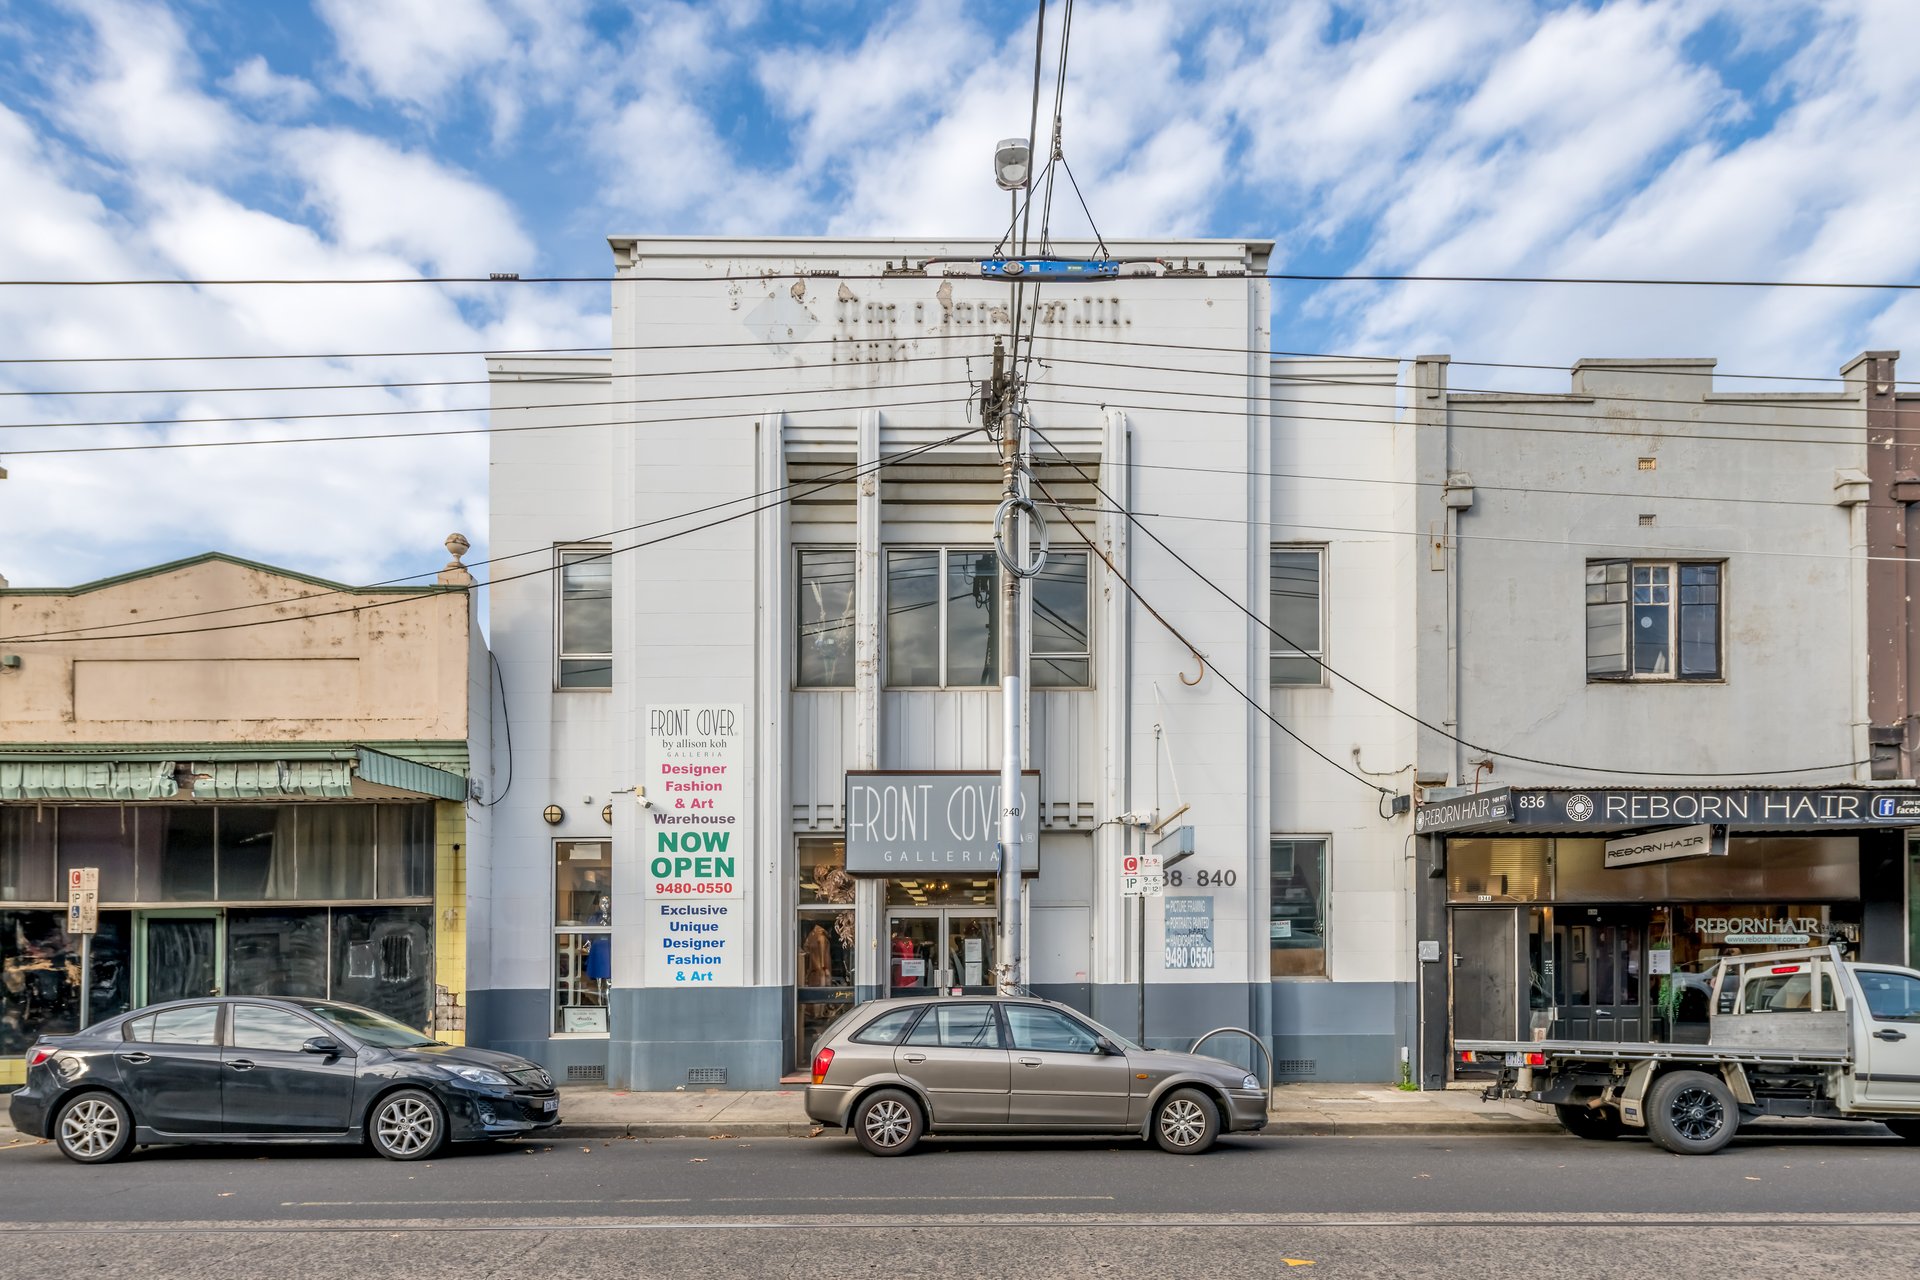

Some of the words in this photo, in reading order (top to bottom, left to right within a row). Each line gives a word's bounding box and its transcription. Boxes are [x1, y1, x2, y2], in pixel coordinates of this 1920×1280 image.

[650, 709, 690, 736] FRONT
[697, 709, 735, 736] COVER
[662, 739, 674, 750] by
[676, 739, 707, 748] allison
[709, 739, 727, 748] koh
[661, 763, 727, 776] Designer
[665, 780, 723, 792] Fashion
[674, 798, 686, 809] &
[691, 798, 714, 809] Art
[1519, 796, 1545, 808] 836
[1606, 795, 1748, 819] REBORN
[1764, 795, 1859, 819] HAIR
[849, 785, 933, 842] FRONT
[1003, 808, 1020, 817] 240
[1424, 806, 1461, 827] REBORN
[1461, 798, 1490, 822] HAIR
[653, 813, 736, 825] Warehouse
[658, 831, 730, 853] NOW
[1608, 844, 1661, 859] REBORN
[1663, 836, 1704, 851] HAIR
[884, 851, 999, 862] GALLERIA
[651, 857, 735, 878] OPEN
[1126, 878, 1137, 888] 1P
[1197, 870, 1236, 887] 840
[655, 883, 733, 894] 9480-0550
[660, 905, 728, 916] Exclusive
[669, 921, 719, 934] Unique
[1695, 918, 1767, 934] REBORN
[1769, 918, 1818, 933] HAIR
[663, 938, 726, 950] Designer
[667, 954, 722, 965] Fashion
[1165, 947, 1188, 968] 9480
[1190, 947, 1212, 968] 0550
[675, 971, 686, 982] &
[690, 971, 713, 982] Art
